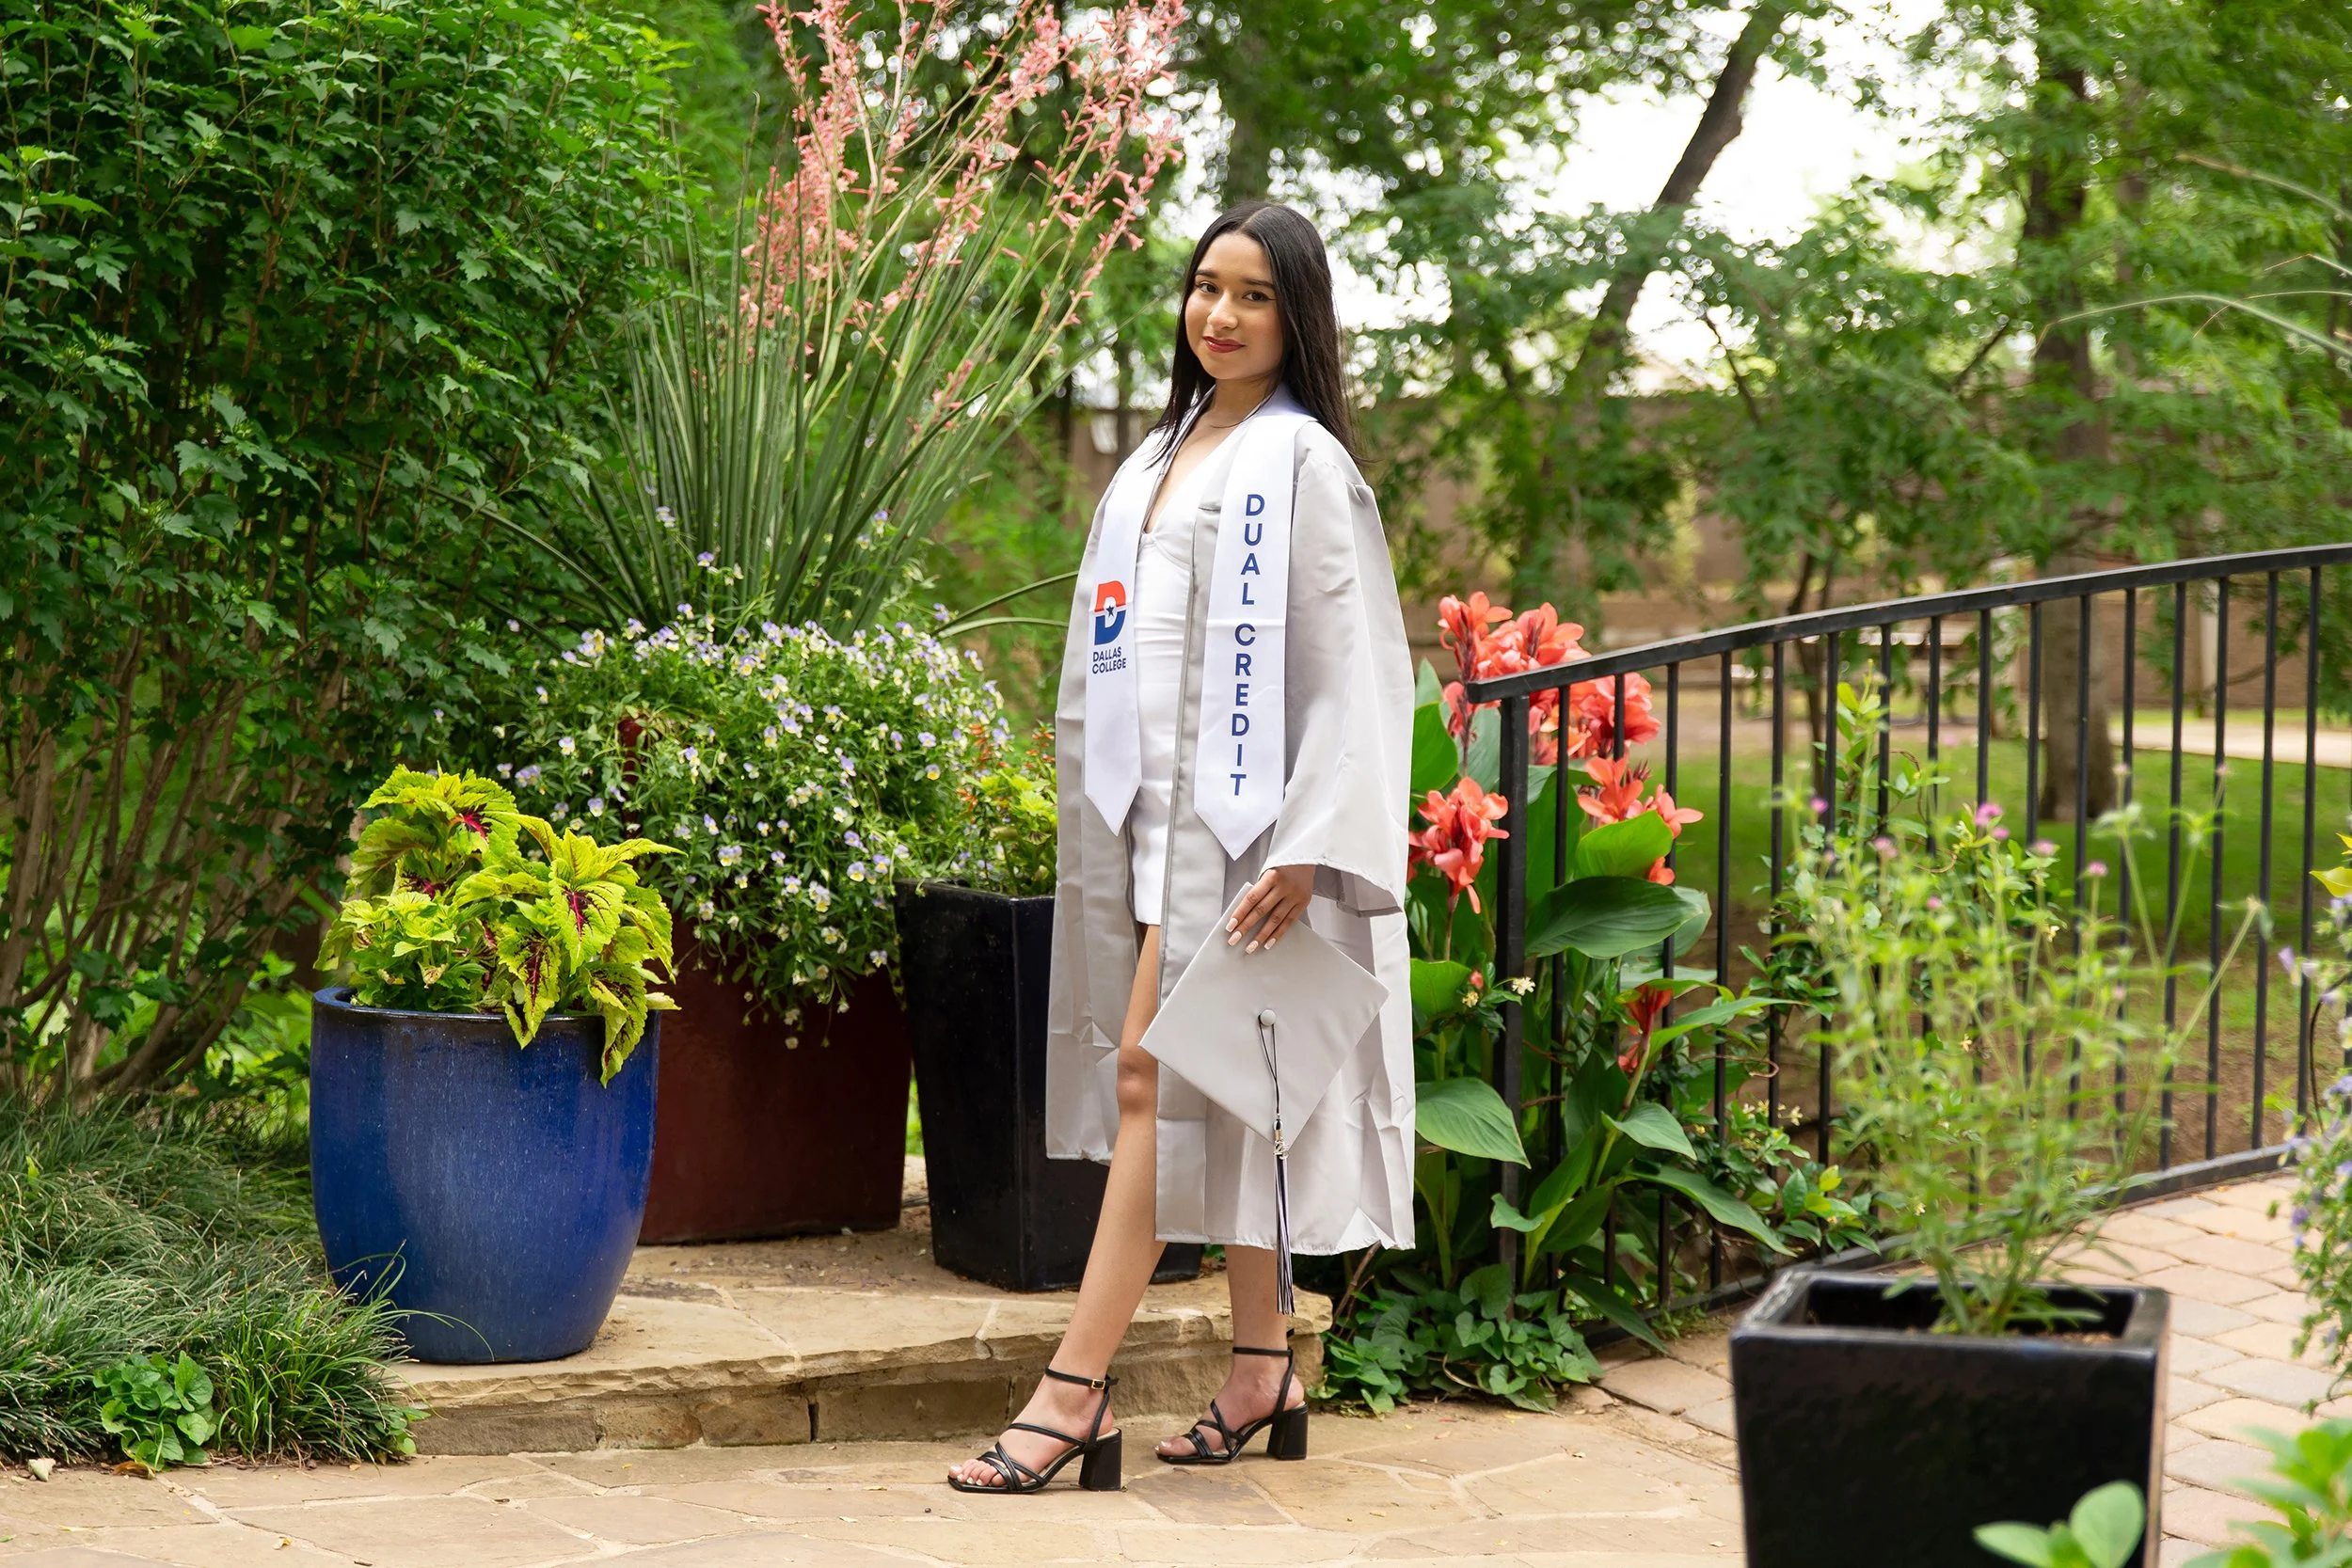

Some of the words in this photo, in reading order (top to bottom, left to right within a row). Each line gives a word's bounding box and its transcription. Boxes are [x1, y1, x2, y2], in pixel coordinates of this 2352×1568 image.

[1241, 494, 1264, 605] DUAL
[1091, 657, 1127, 674] COLLEGE
[1092, 646, 1121, 662] DALLAS
[1231, 624, 1256, 796] CREDIT
